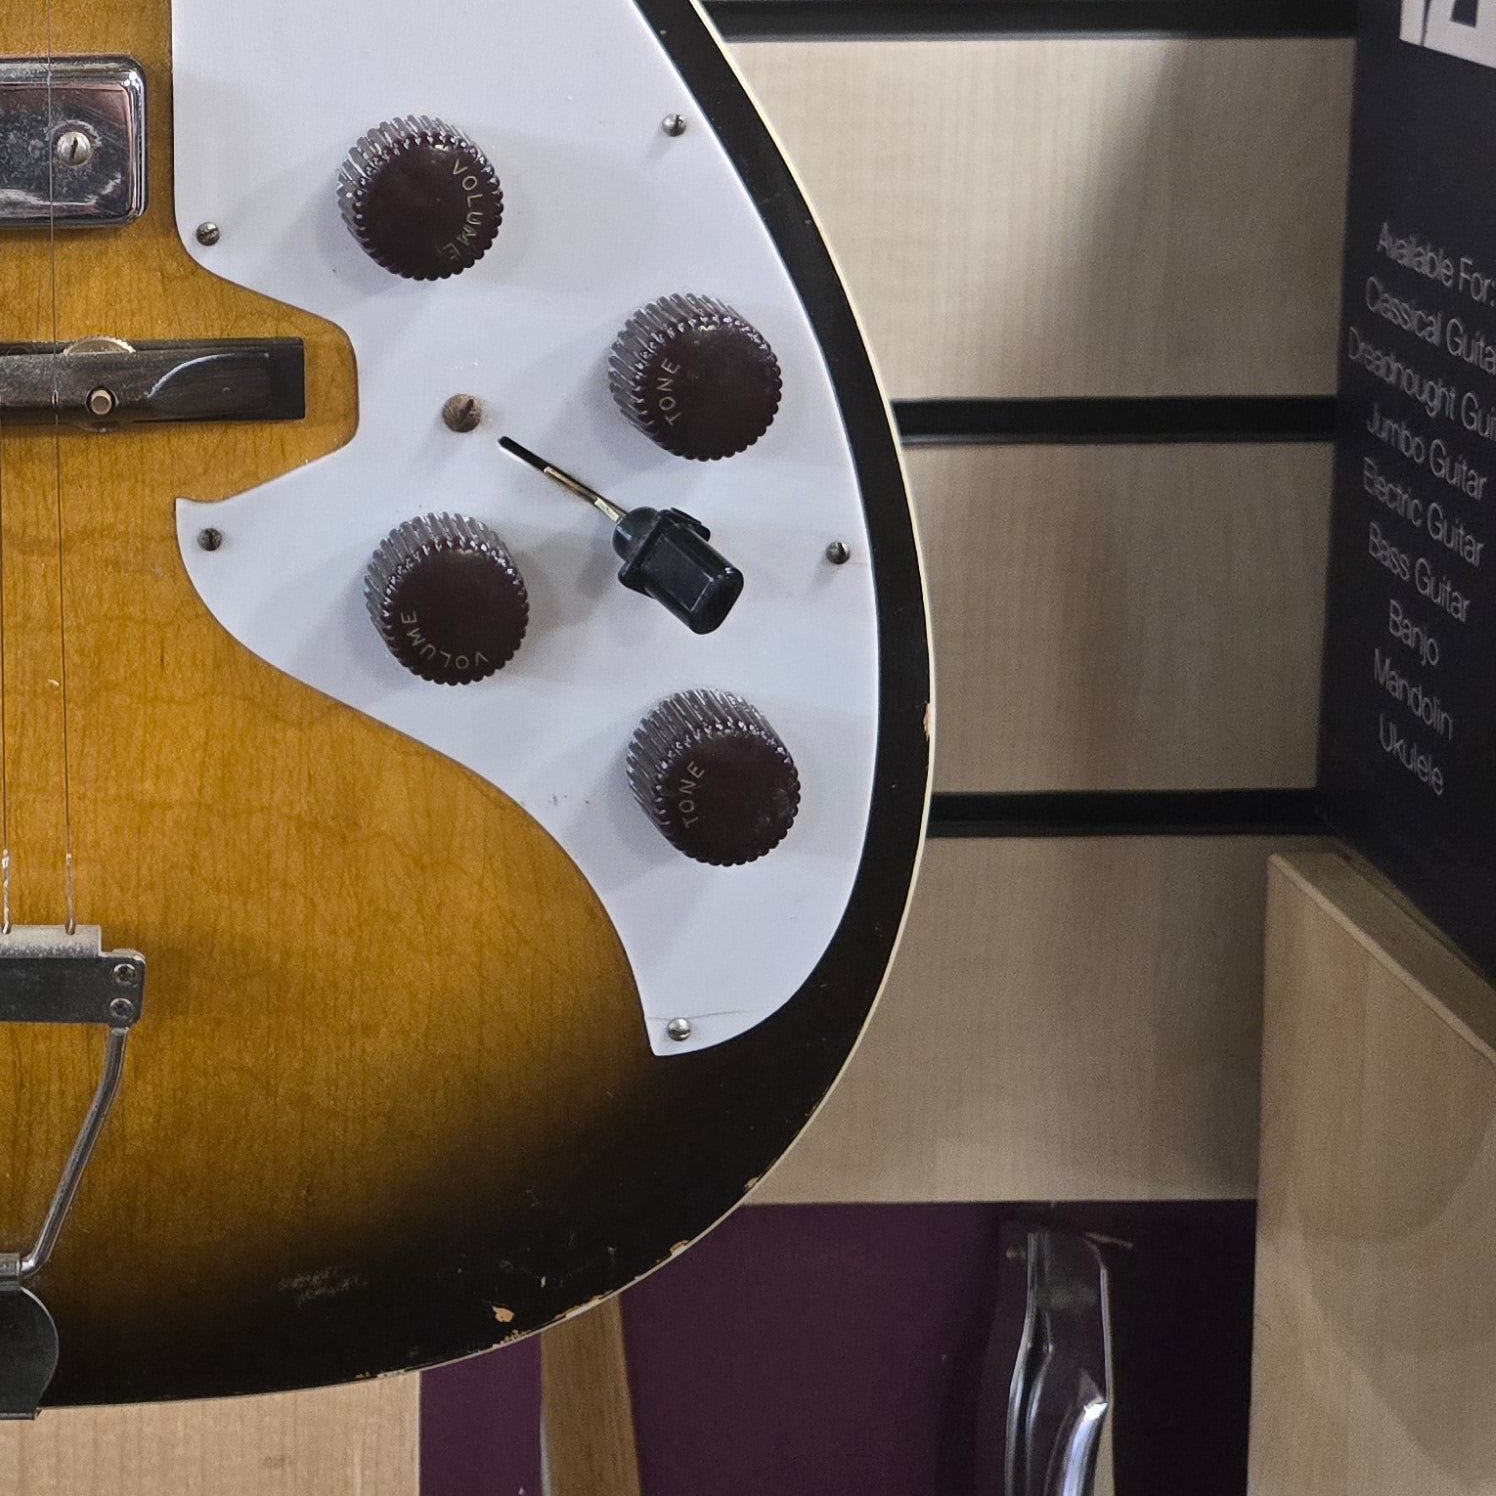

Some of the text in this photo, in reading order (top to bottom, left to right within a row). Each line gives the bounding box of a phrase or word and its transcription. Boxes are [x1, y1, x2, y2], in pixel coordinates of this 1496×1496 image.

[438, 160, 484, 262] VOLUME
[1377, 221, 1454, 287] Available
[1365, 276, 1496, 375] Classical Guita
[656, 358, 681, 426] TONE
[1348, 326, 1455, 420] Dreadnought
[1366, 402, 1487, 500] Jumbo Guitar
[1363, 456, 1484, 566] Electric Guitar
[1369, 522, 1470, 622] Bass Guitar
[401, 610, 488, 669] VOLUME
[1389, 599, 1440, 666] Banjo
[1374, 647, 1453, 740] Mandolin
[679, 761, 704, 829] TONE
[1378, 712, 1444, 795] Ukulele
